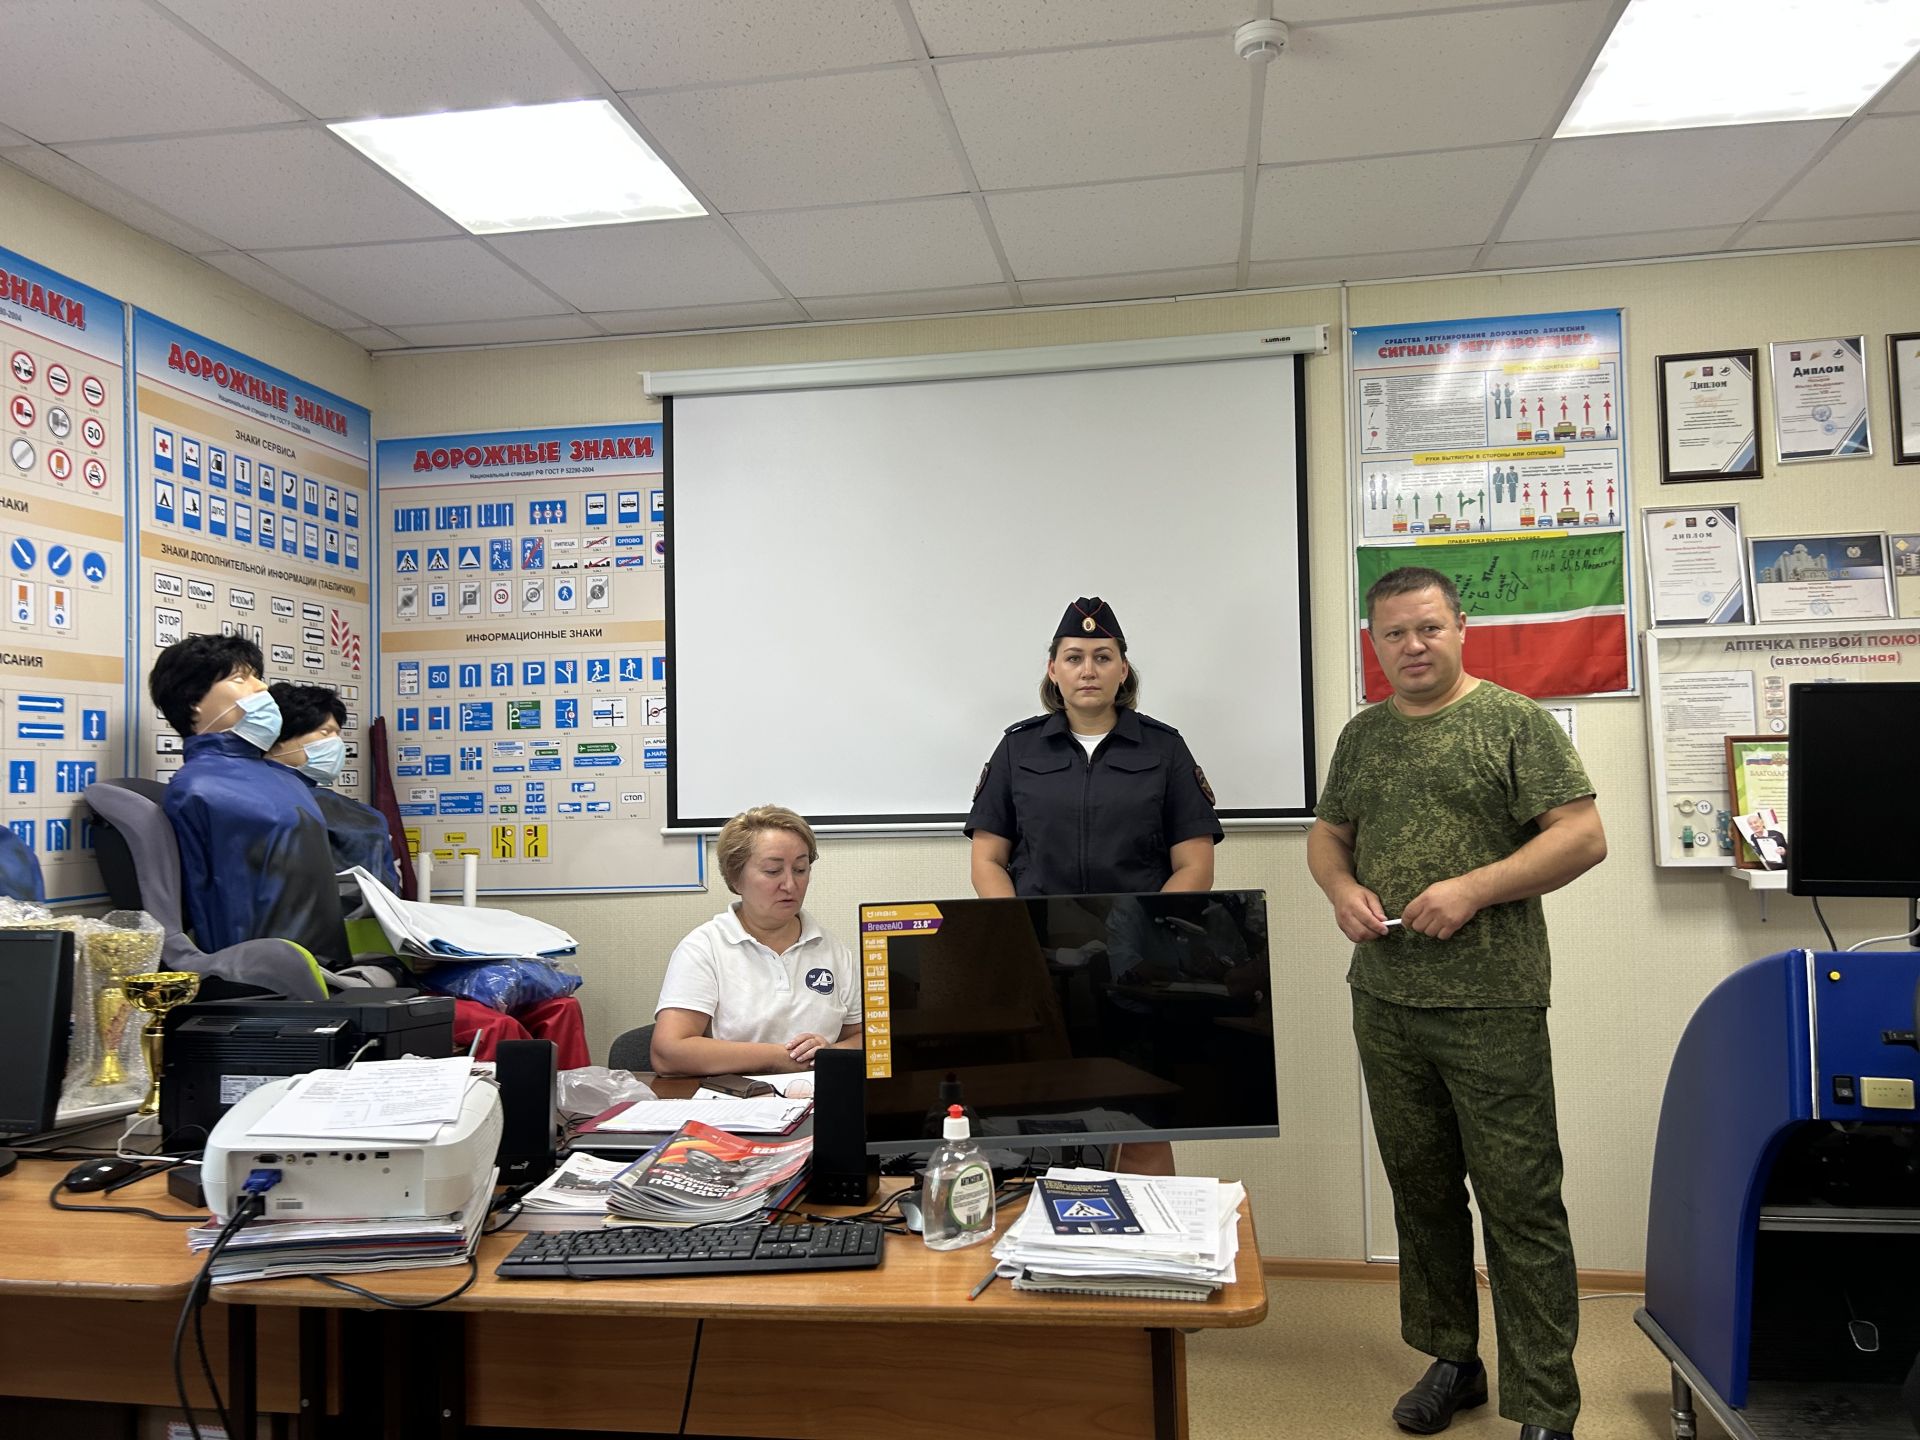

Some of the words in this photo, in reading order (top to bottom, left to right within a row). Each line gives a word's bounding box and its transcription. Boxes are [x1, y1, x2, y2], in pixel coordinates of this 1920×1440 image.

[1384, 336, 1421, 345] СРЕДСТВА
[1489, 328, 1539, 338] ДОРОЖНОГО
[1378, 342, 1450, 359] СИГНАЛЫ
[1793, 365, 1845, 377] Диплом
[168, 342, 289, 413] ДОРОЖНЫЕ
[293, 395, 348, 437] ЗНАКИ
[1689, 380, 1728, 391] Диплом
[87, 427, 101, 440] 50
[235, 429, 261, 446] ЗНАКИ
[262, 438, 296, 460] СЕРВИСА
[413, 441, 561, 472] ДОРОЖНЫЕ
[569, 436, 655, 462] ЗНАКИ
[161, 543, 189, 560] ЗНАКИ
[190, 550, 266, 577] ДОПОЛНИТЕЛЬНОЙ
[267, 568, 317, 588] ИНФОРМАЦИИ
[318, 577, 356, 596] (ТАБЛИЧКИ)
[157, 579, 172, 591] 300
[158, 614, 180, 626] STOP
[465, 629, 567, 643] ИНФОРМАЦИОННЫЕ
[569, 628, 603, 638] ЗНАКИ
[1725, 638, 1795, 652] АПТЕЧКА
[1799, 634, 1862, 649] ПЕРВОЙ
[1770, 651, 1902, 669] (автомобильная)
[431, 671, 447, 683] 50
[527, 664, 542, 683] P
[341, 773, 351, 784] 15
[867, 921, 903, 931] BreezeAIO
[869, 953, 882, 961] IPS
[867, 1010, 888, 1019] HDMI
[662, 1174, 739, 1193] ВЕЛИКОЙ
